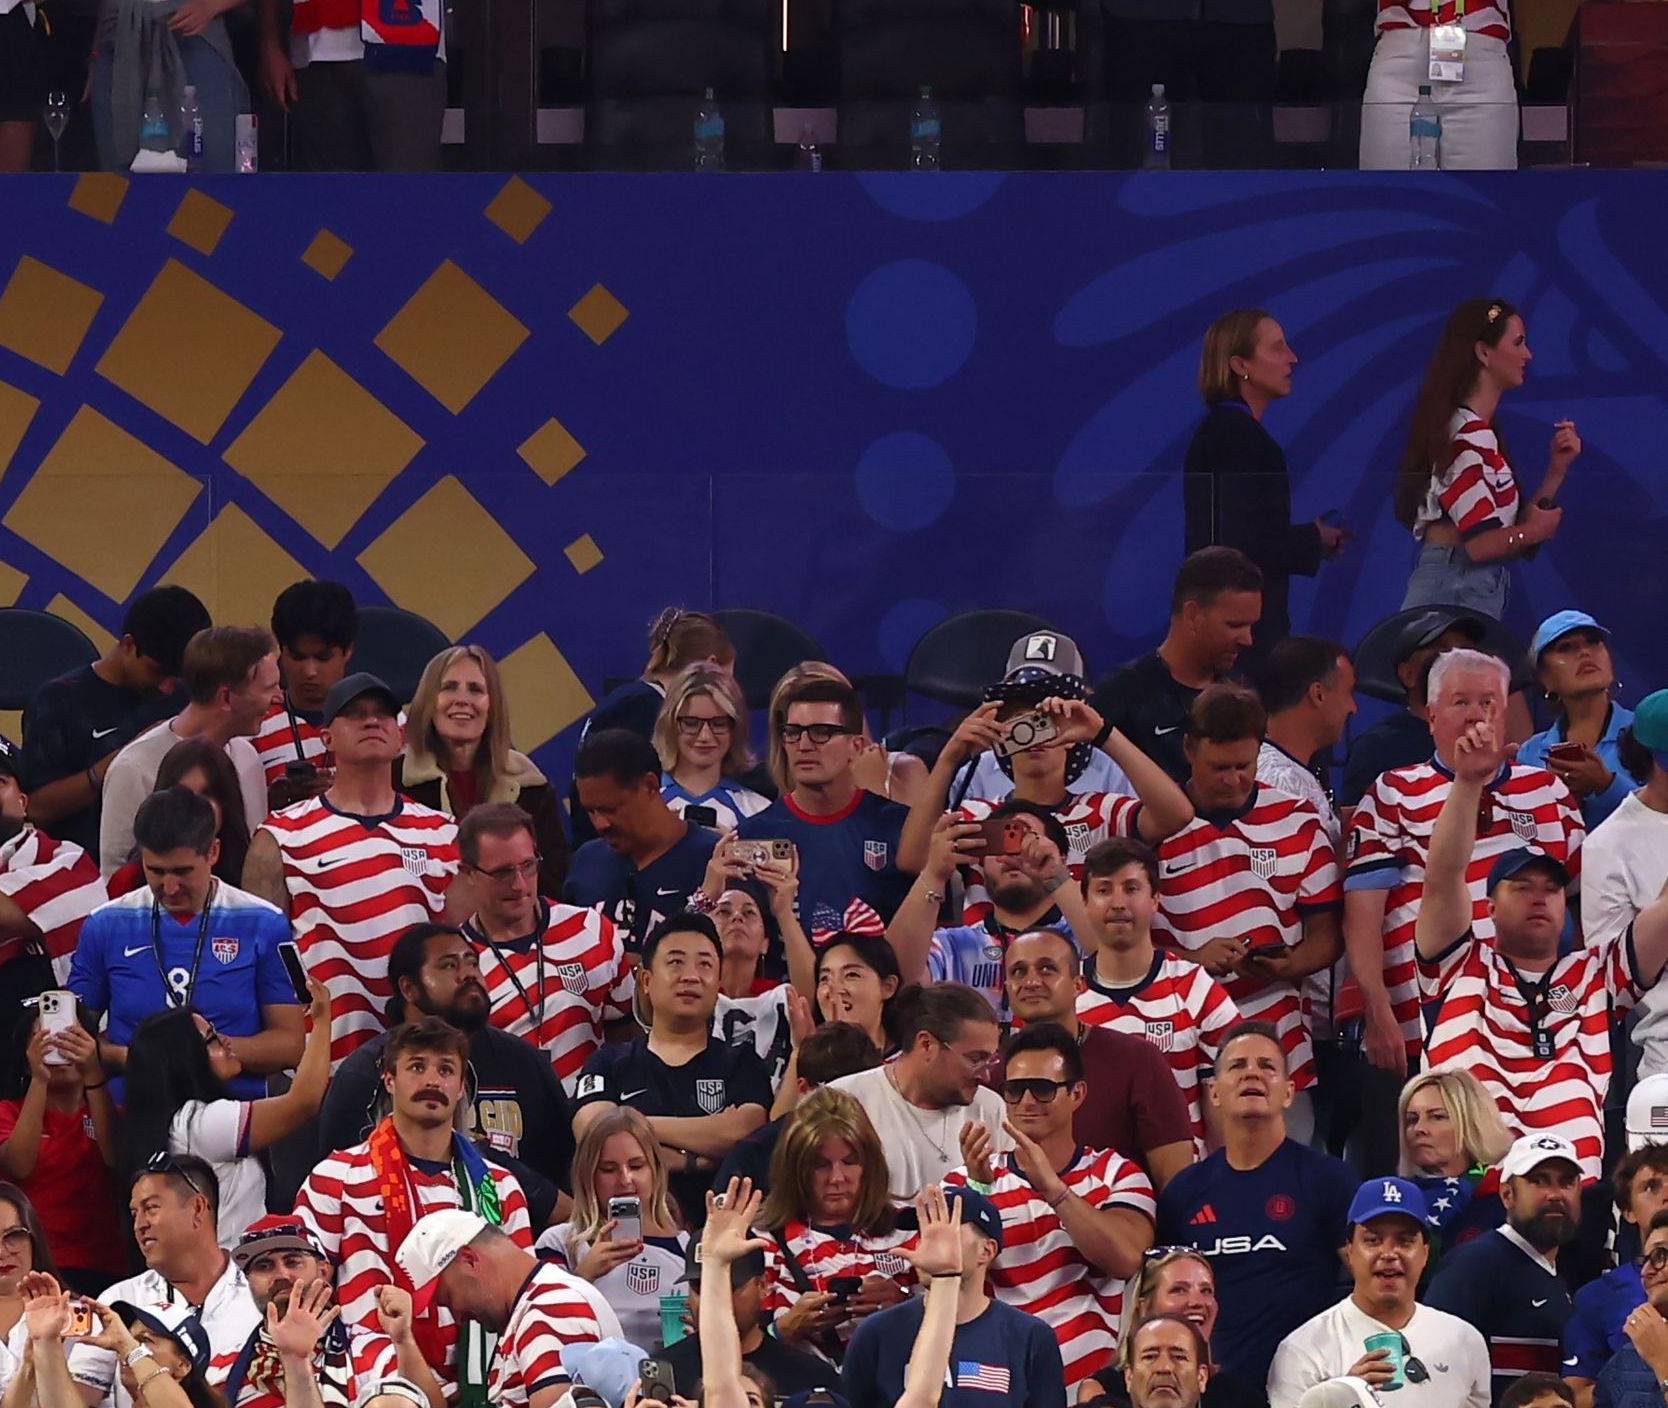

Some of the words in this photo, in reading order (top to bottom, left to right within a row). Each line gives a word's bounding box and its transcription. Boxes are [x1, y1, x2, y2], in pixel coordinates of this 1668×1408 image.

[165, 967, 190, 1008] 8
[1383, 1181, 1402, 1202] LA
[630, 1265, 658, 1278] USA
